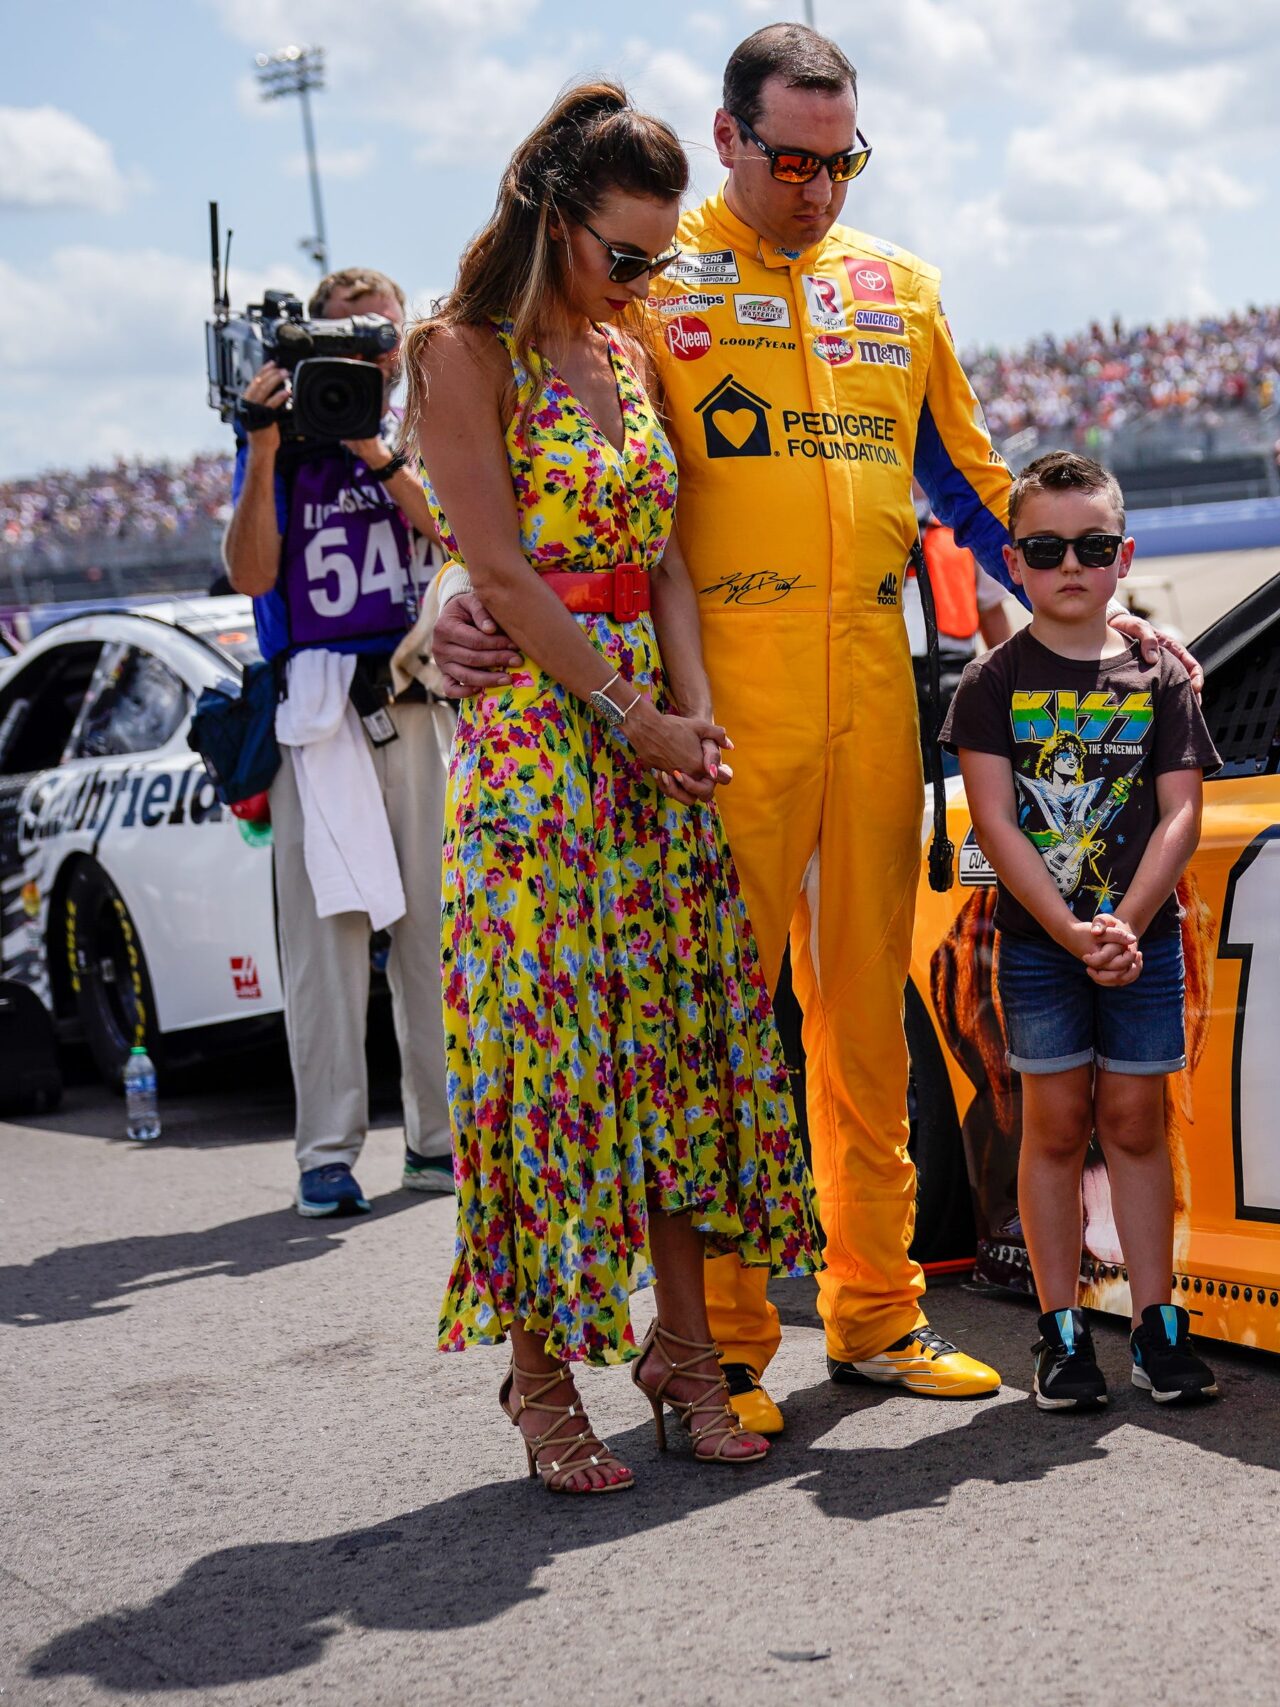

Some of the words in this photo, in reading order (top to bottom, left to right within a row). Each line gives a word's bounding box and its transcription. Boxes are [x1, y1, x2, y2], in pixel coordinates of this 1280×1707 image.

[740, 305, 783, 314] INTERSTATE
[742, 311, 781, 319] BATTERIES
[857, 311, 899, 328] SNICKERS
[667, 316, 711, 355] Rheem
[720, 337, 796, 350] GOODYEAR
[782, 410, 897, 441] PEDIGREE
[788, 439, 898, 466] FOUNDATION
[304, 519, 409, 617] 54
[877, 596, 898, 605] TOOLS
[1010, 689, 1154, 743] KISS
[1088, 743, 1102, 754] THE
[1104, 744, 1143, 755] SPACEMAN
